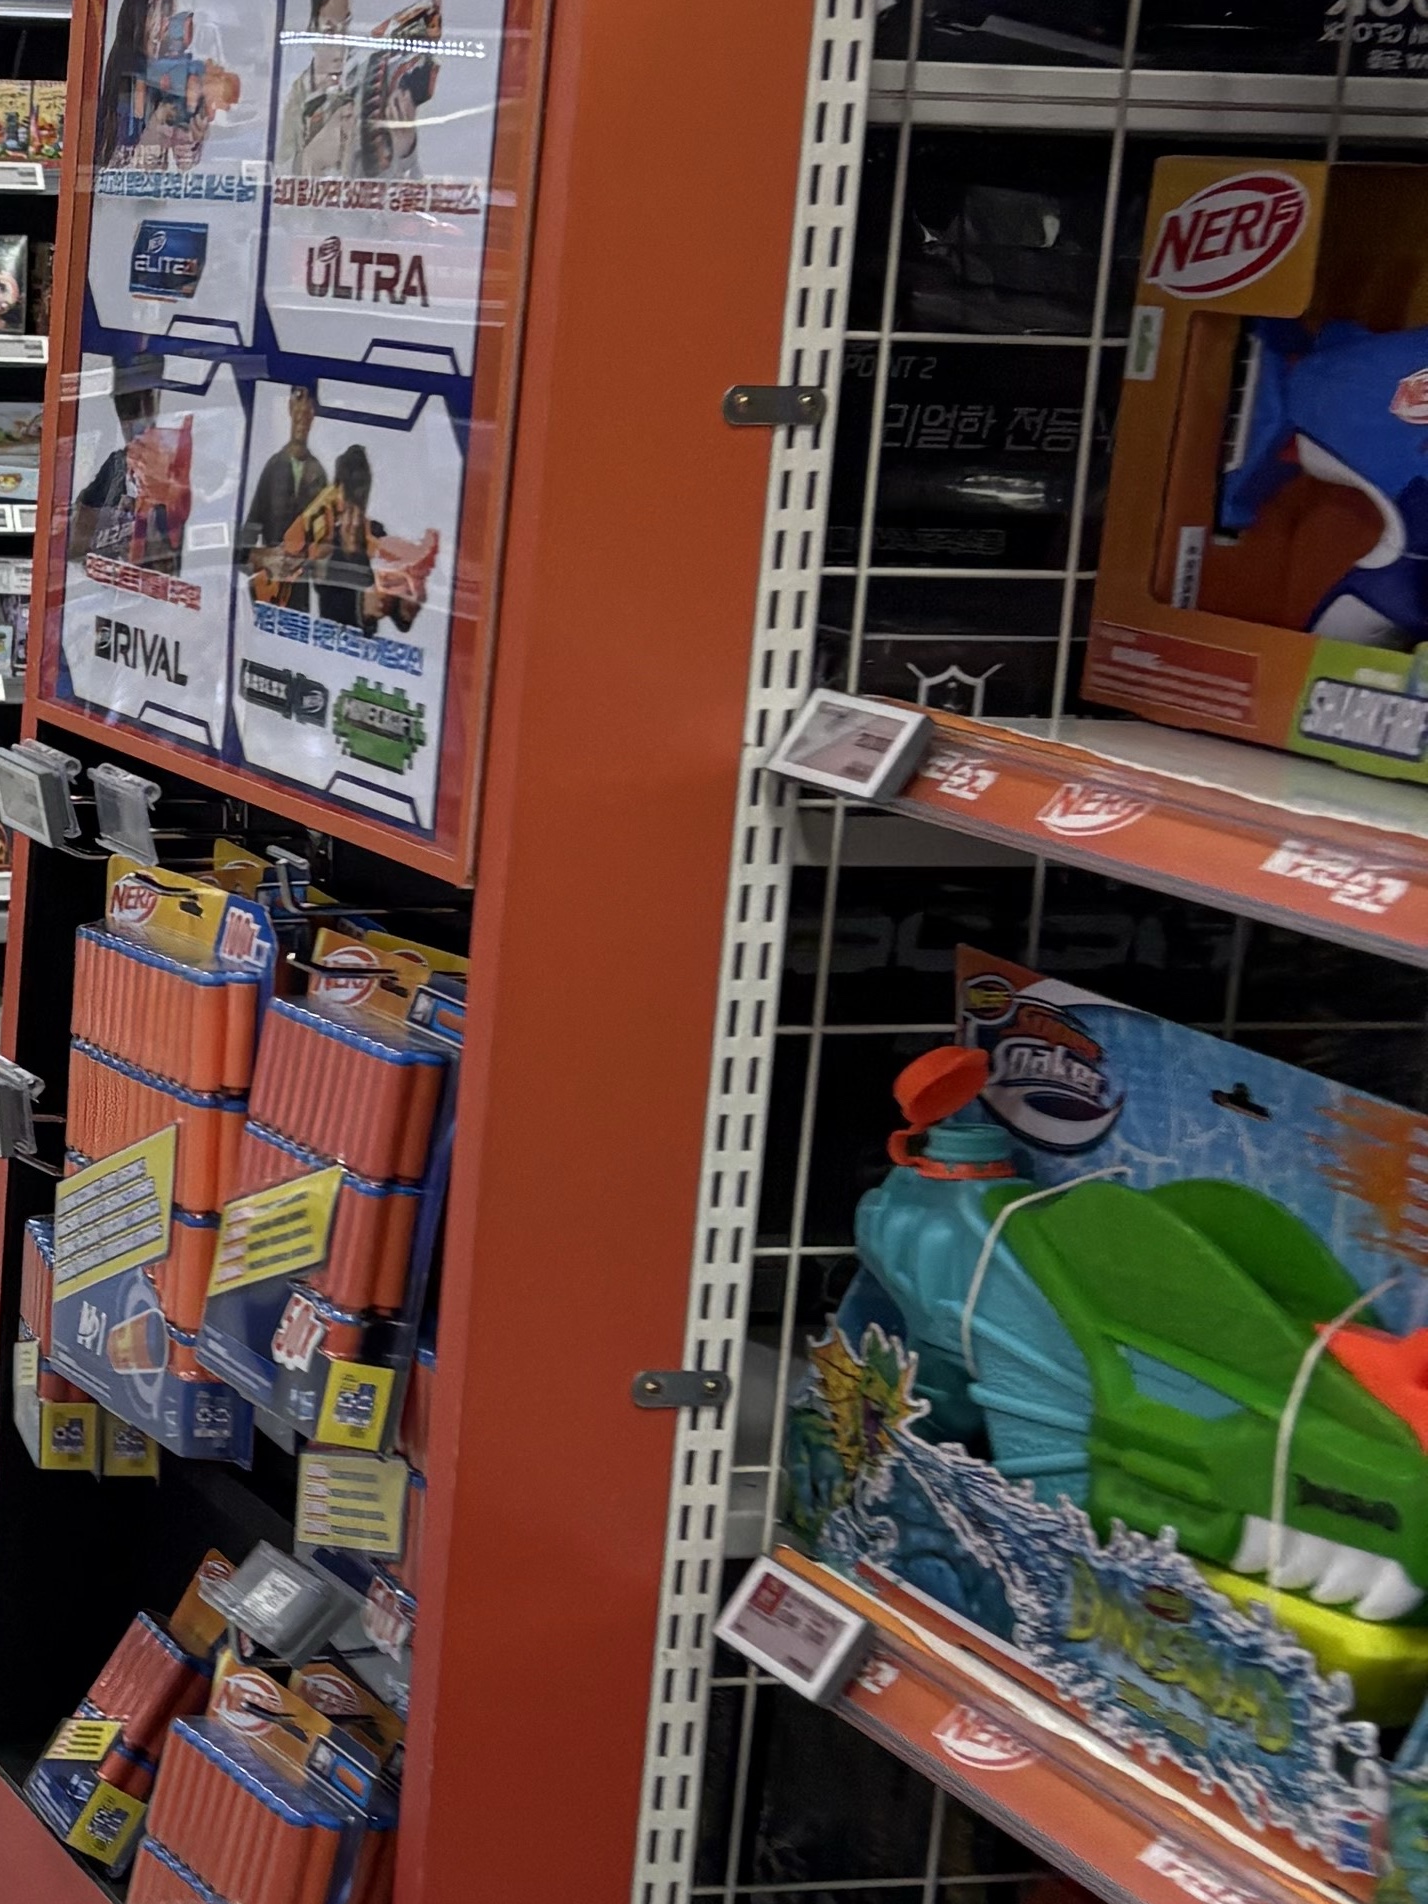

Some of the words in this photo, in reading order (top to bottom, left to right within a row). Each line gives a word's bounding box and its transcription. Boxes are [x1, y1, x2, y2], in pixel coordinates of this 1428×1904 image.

[1148, 184, 1308, 280] NERF
[305, 243, 430, 307] ULTRA
[113, 621, 188, 687] RIVAL
